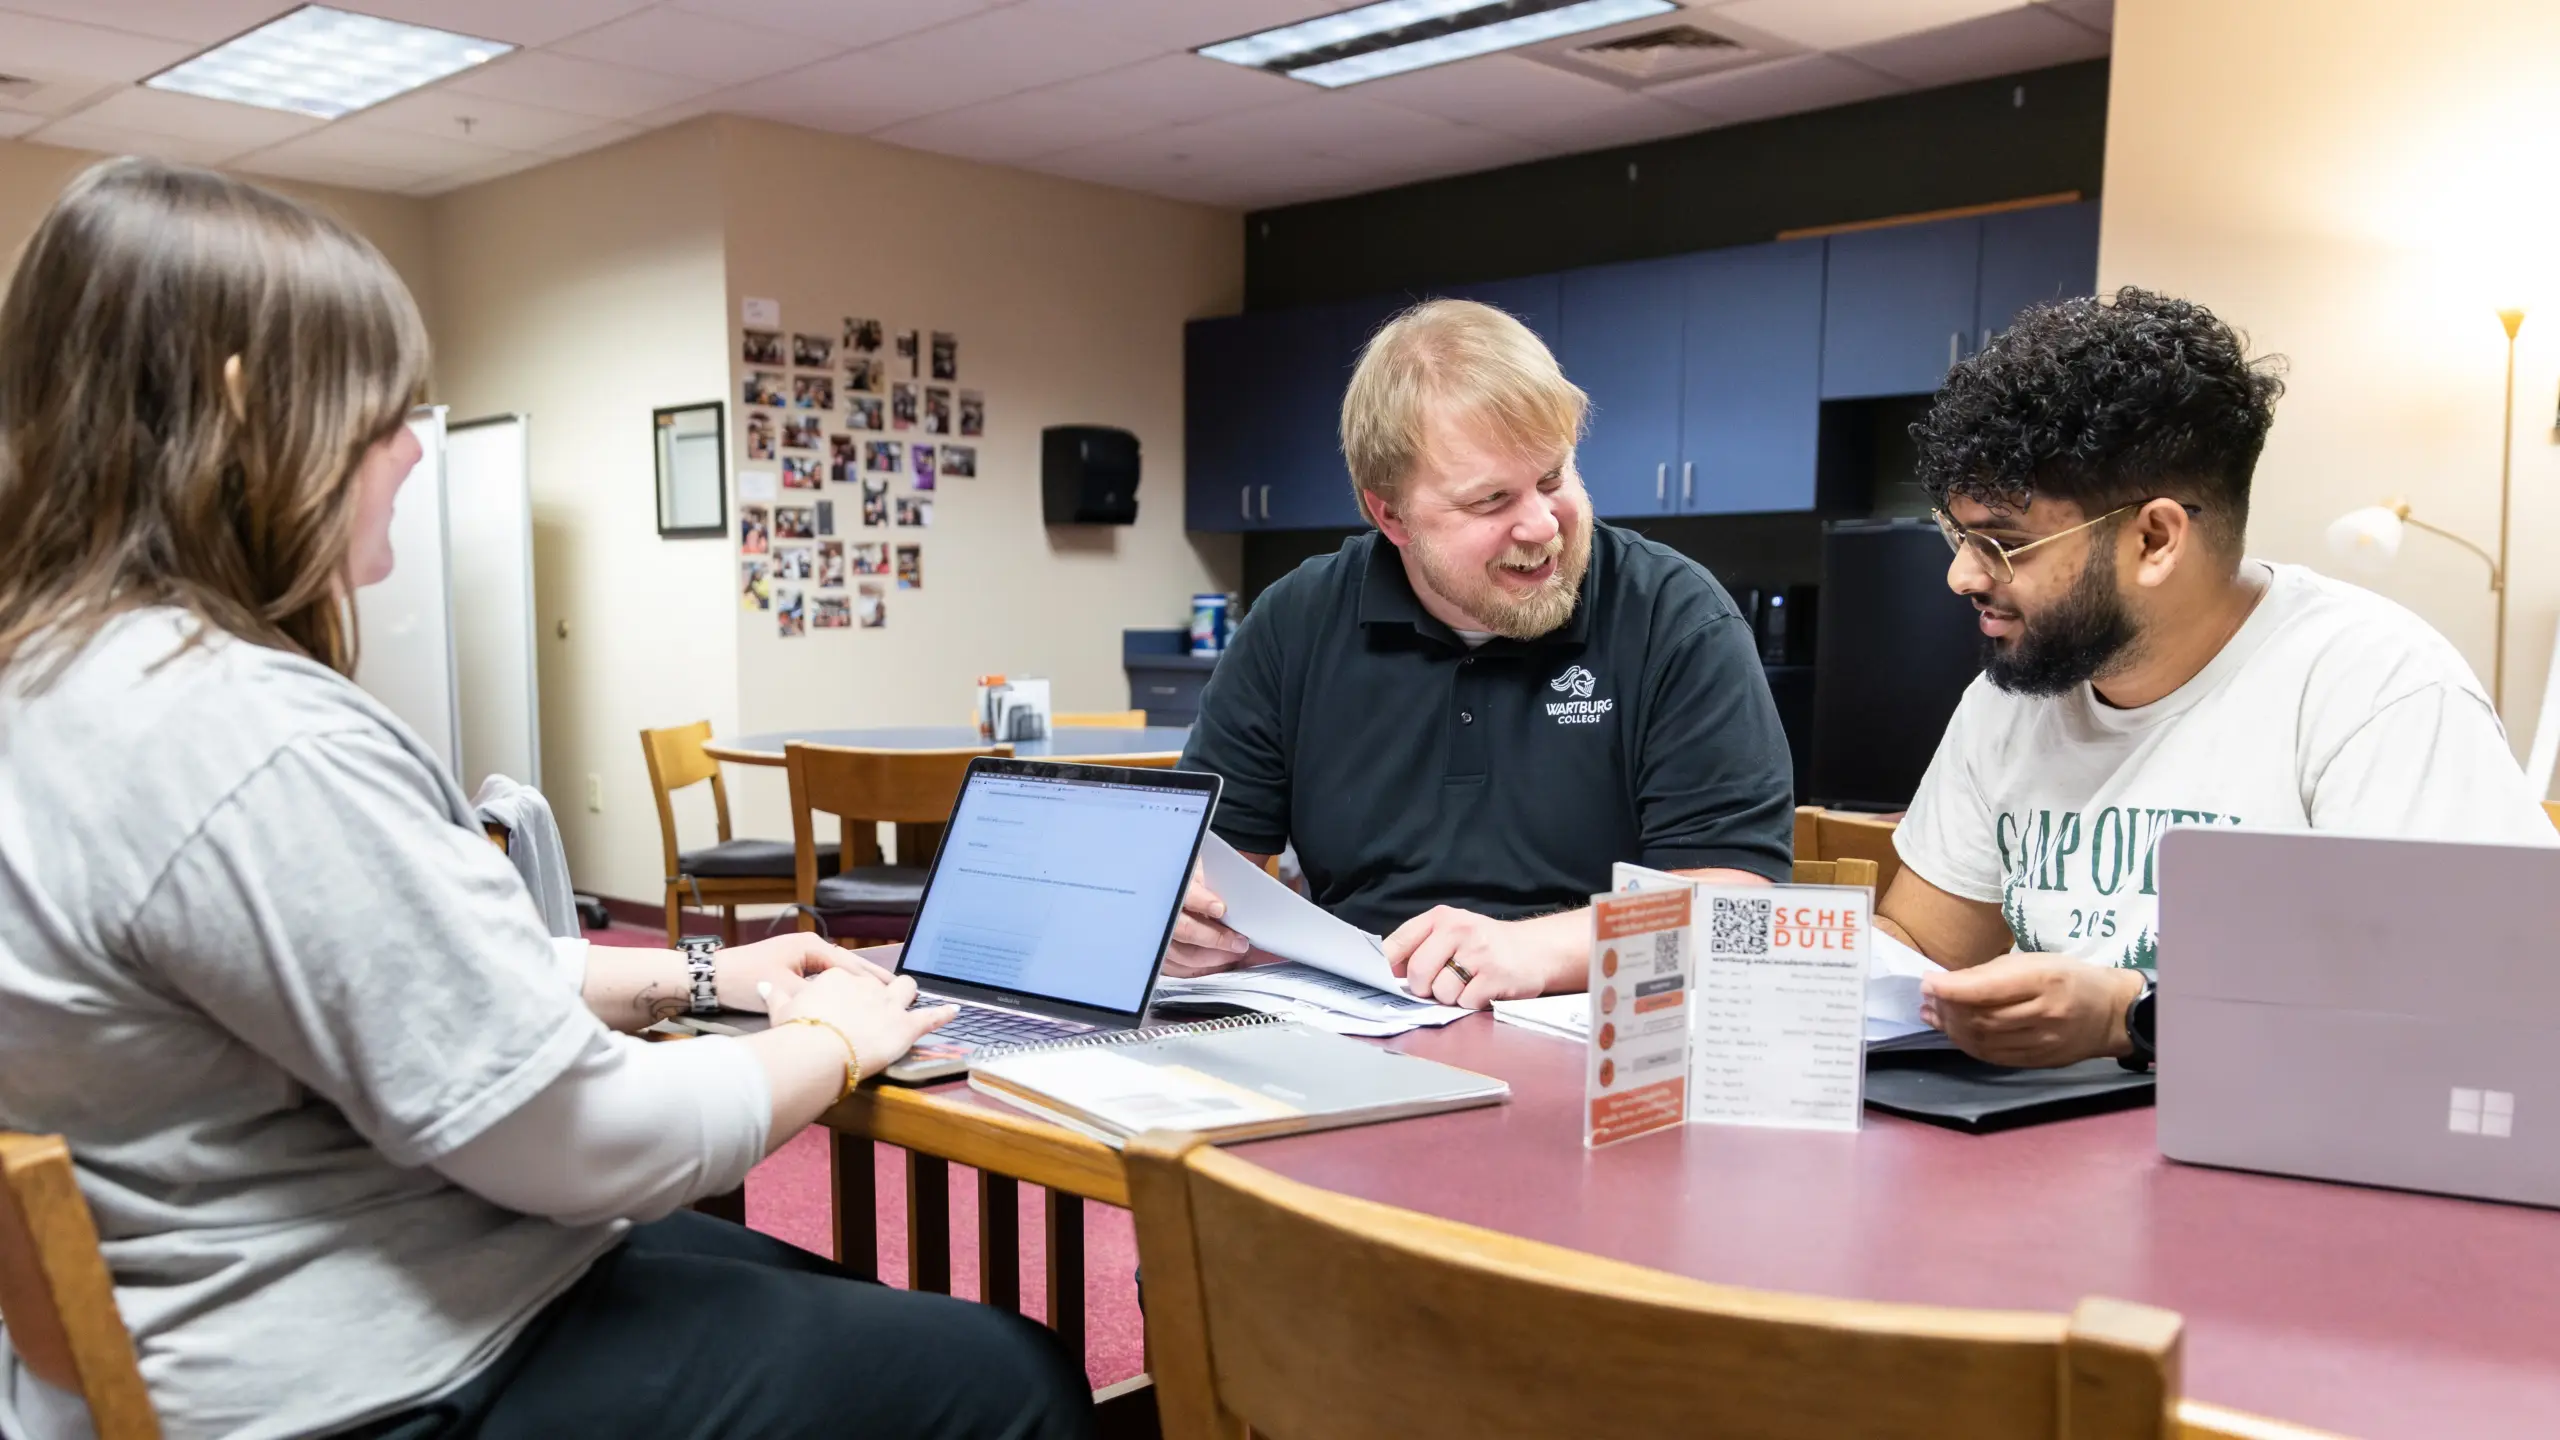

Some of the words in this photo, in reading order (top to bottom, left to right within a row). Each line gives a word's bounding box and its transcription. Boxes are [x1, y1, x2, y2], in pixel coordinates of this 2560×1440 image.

[1546, 699, 1612, 715] WARTBURG
[1558, 714, 1601, 724] COLLEGE
[1774, 907, 1857, 928] SCHE
[1773, 929, 1855, 950] DULE
